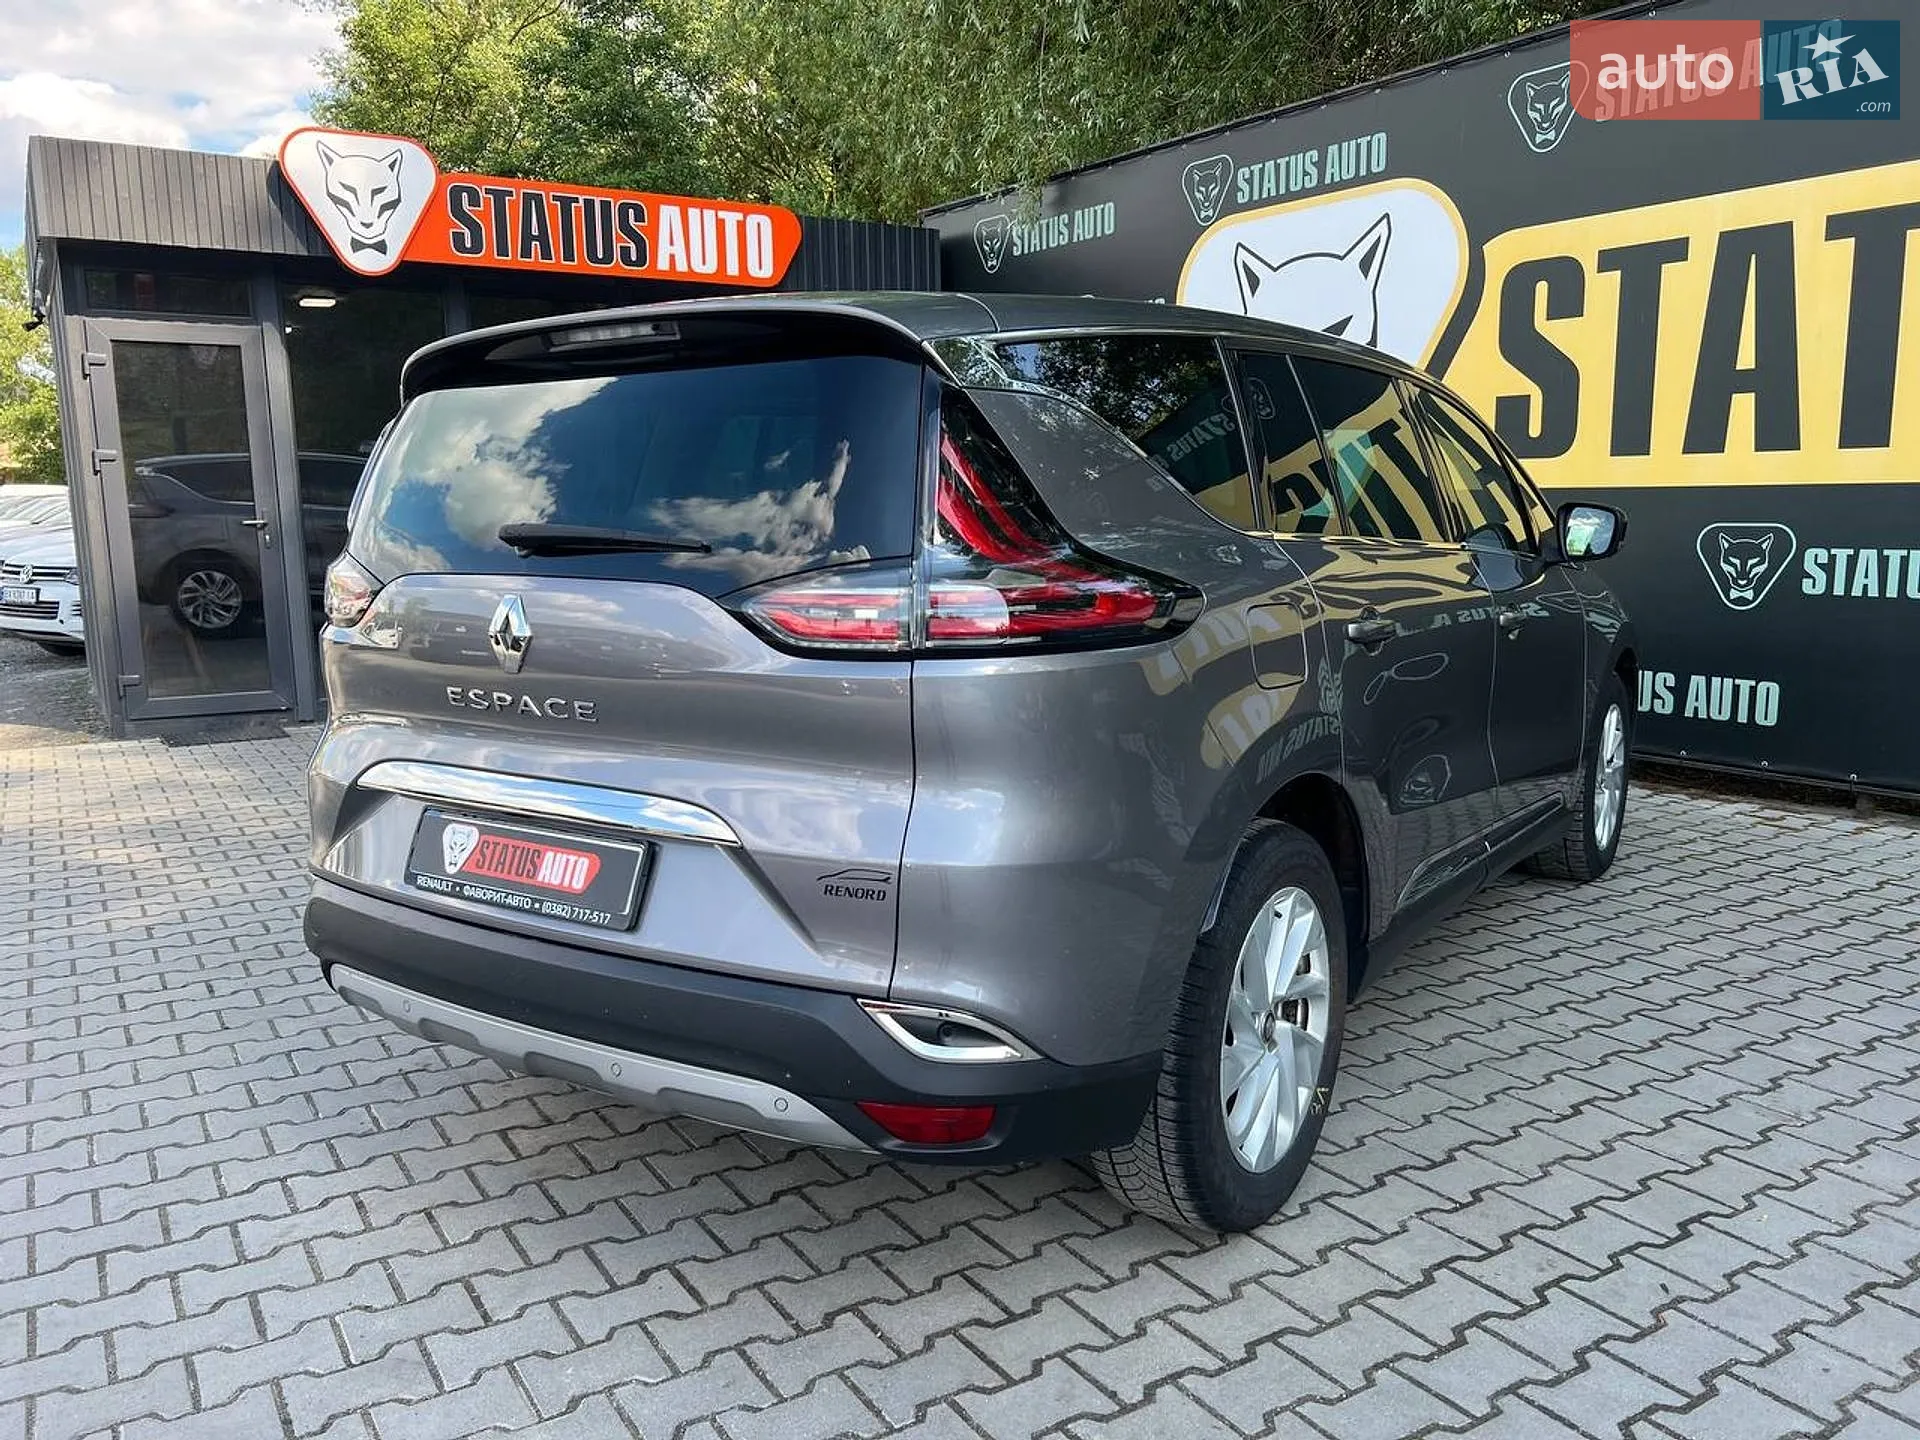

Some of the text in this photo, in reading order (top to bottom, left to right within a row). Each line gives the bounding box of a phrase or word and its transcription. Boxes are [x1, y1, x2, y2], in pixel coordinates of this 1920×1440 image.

[1236, 131, 1388, 204] STATUS AUTO
[447, 183, 774, 279] STATUS AUTO
[1012, 202, 1115, 256] STATUS AUTO
[1495, 202, 1920, 459] STAT
[446, 686, 599, 723] ESPACE
[1684, 674, 1780, 727] AUTO
[475, 839, 590, 889] STATUS AUTO
[416, 875, 611, 924] RENAULT ФАВОРИТ-АВТО (0382) 717-517
[823, 884, 887, 901] RENORD
